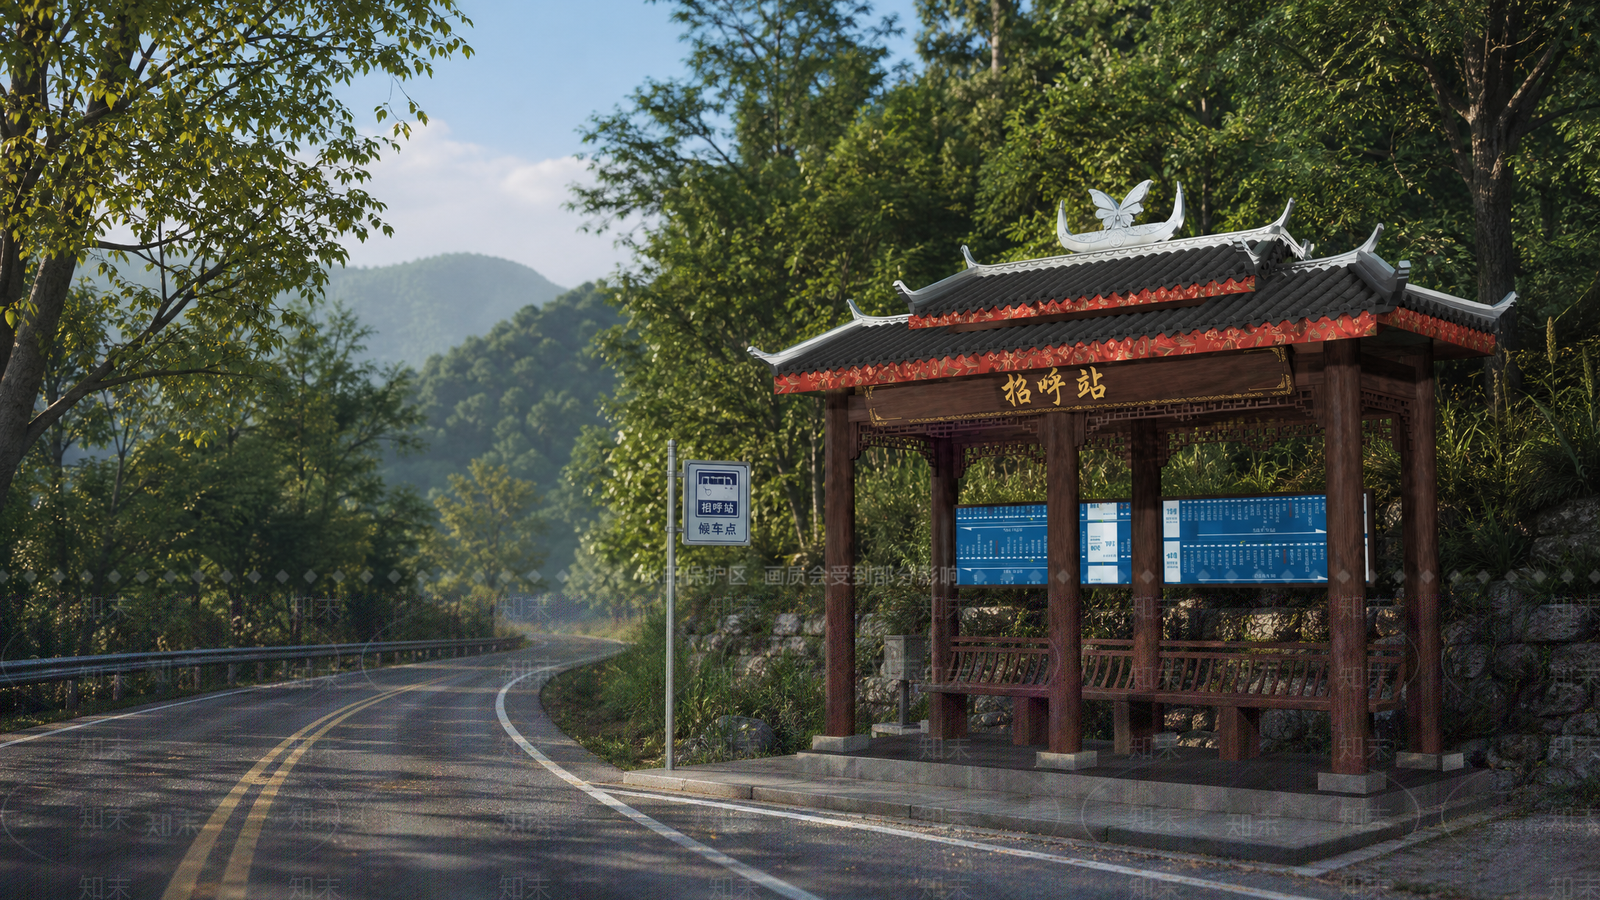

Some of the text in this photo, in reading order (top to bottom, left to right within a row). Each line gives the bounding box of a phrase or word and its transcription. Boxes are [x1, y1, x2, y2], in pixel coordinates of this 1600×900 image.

[1001, 366, 1106, 407] 招呼站
[698, 522, 737, 535] 候车点
